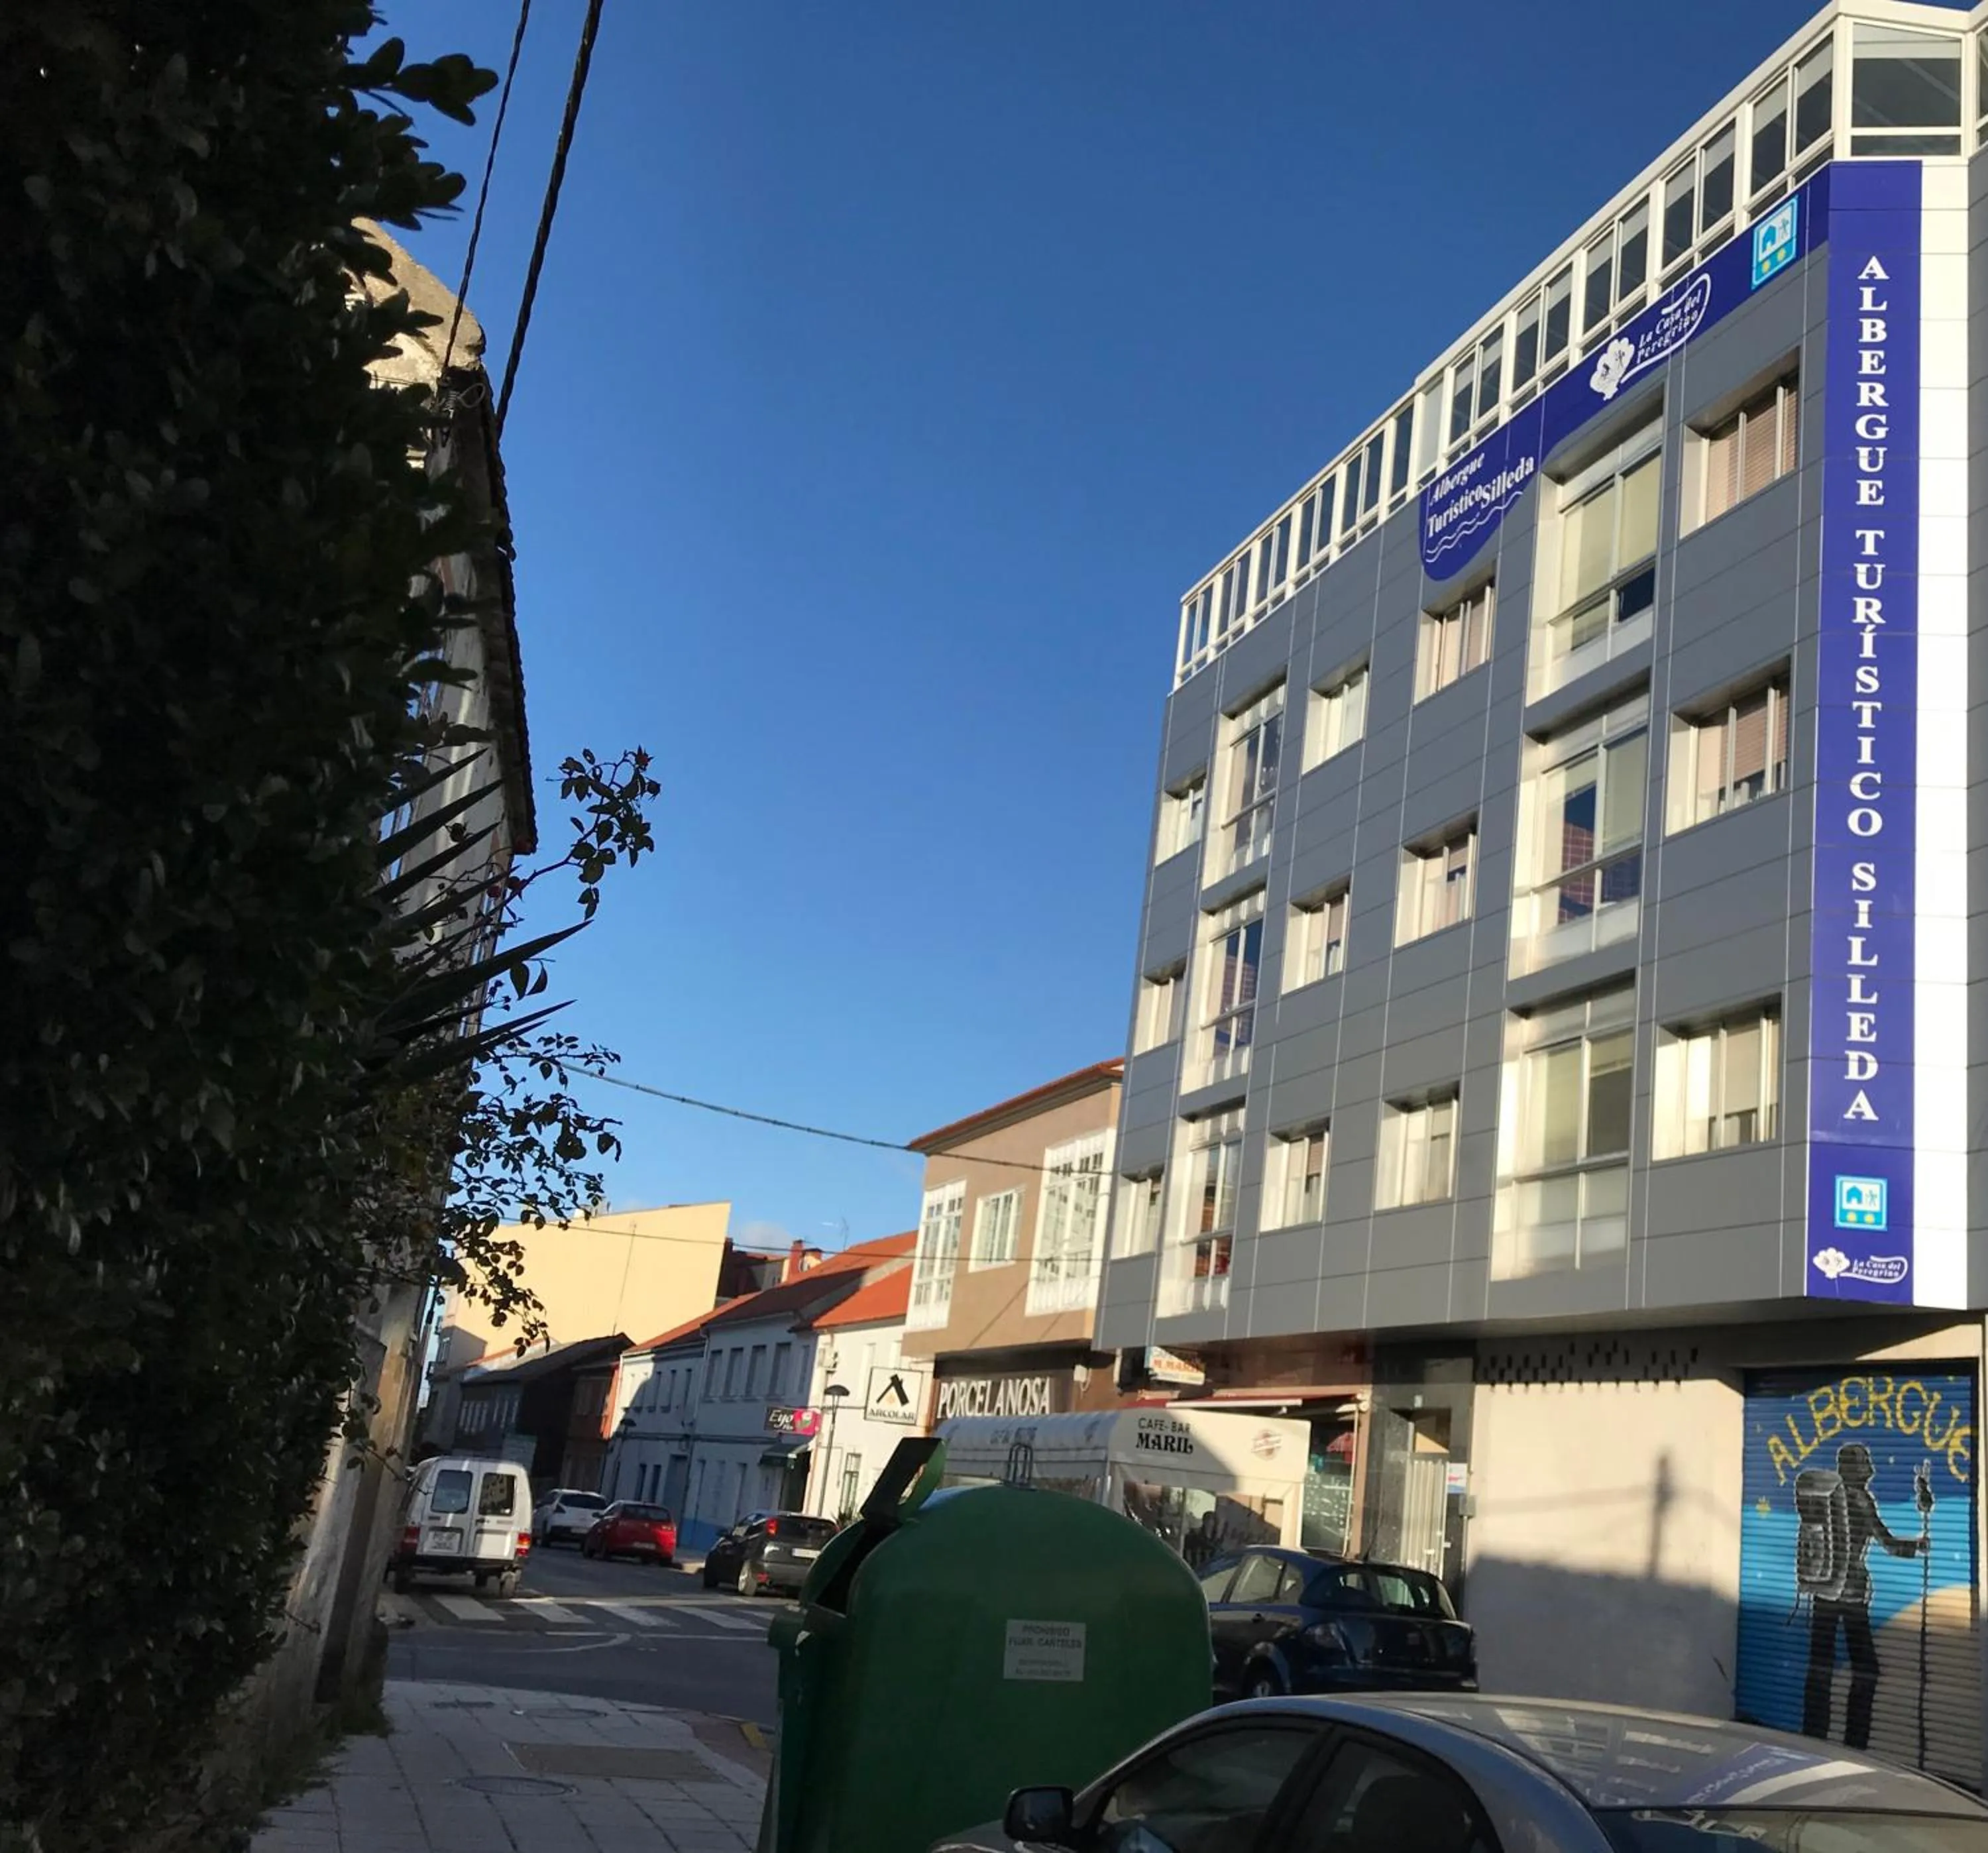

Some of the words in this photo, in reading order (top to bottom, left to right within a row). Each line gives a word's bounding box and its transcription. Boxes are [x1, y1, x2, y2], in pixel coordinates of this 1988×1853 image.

[1636, 309, 1698, 364] Peregrino
[1639, 332, 1653, 349] La
[1655, 308, 1682, 335] Casa
[1683, 288, 1702, 313] del
[1855, 255, 1890, 506] ALBERGUE
[1429, 452, 1485, 507] Albergue
[1847, 529, 1887, 837] TURÍSTICO
[1843, 862, 1879, 1122] SILLEDA
[869, 1408, 916, 1421] ARCOLAR
[936, 1376, 1051, 1419] PORCELANOSA
[1170, 1420, 1191, 1433] BAR
[1767, 1376, 1971, 1487] ALBERGUE
